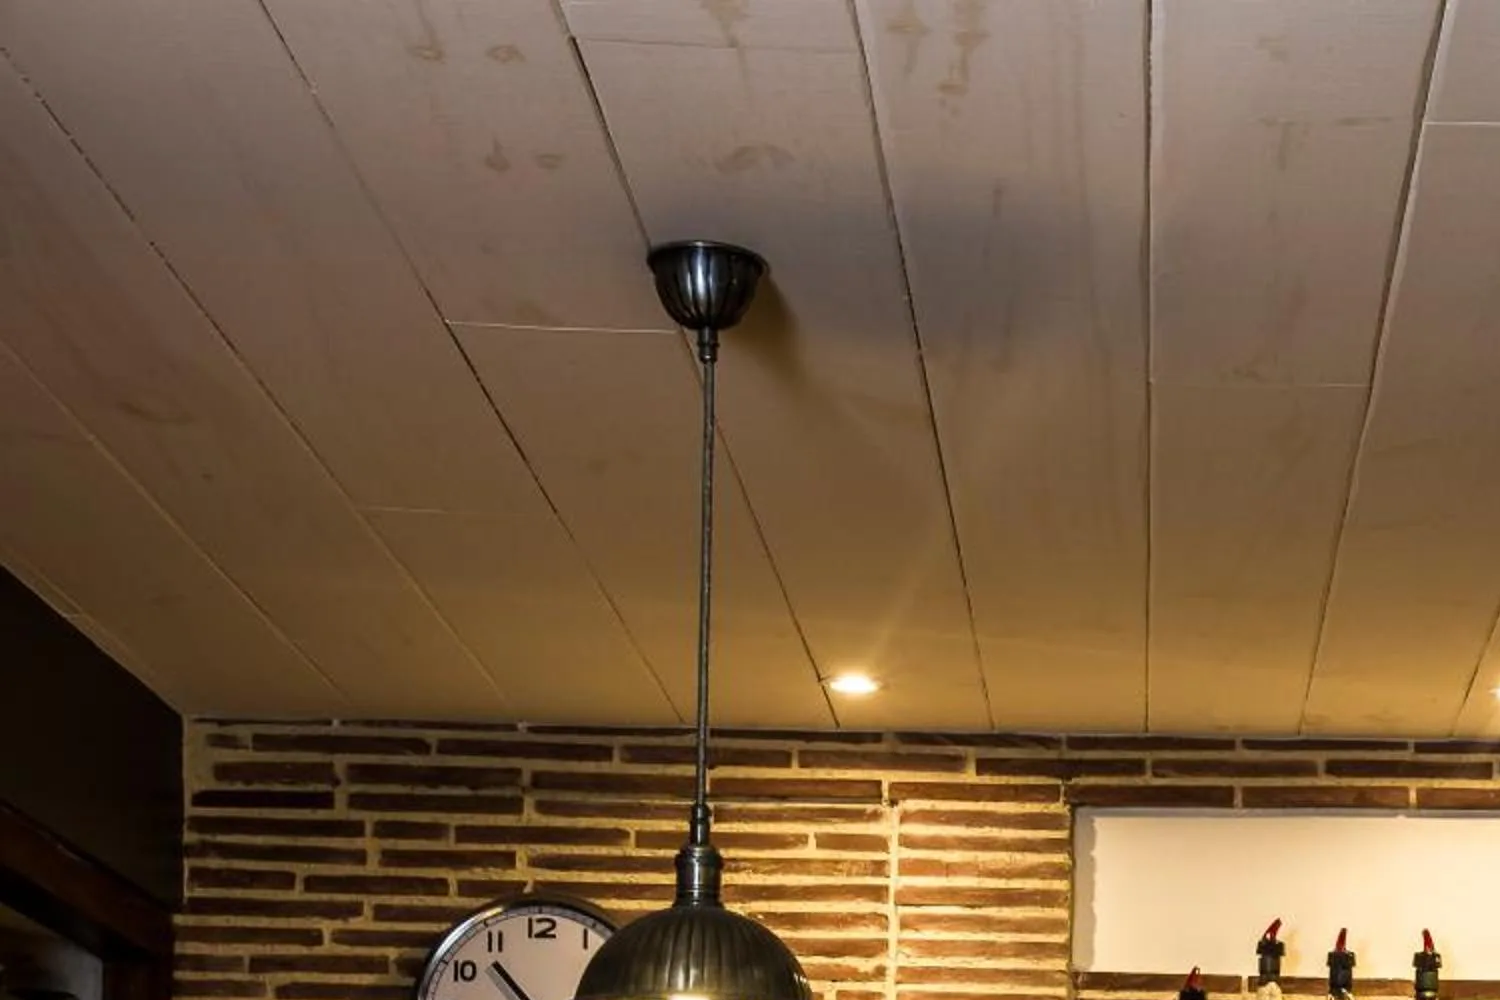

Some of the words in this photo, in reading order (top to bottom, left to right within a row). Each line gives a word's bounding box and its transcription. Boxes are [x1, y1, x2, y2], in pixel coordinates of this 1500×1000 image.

[527, 917, 557, 939] 12
[582, 928, 589, 950] 1
[487, 930, 503, 952] 11
[453, 960, 477, 982] 10
